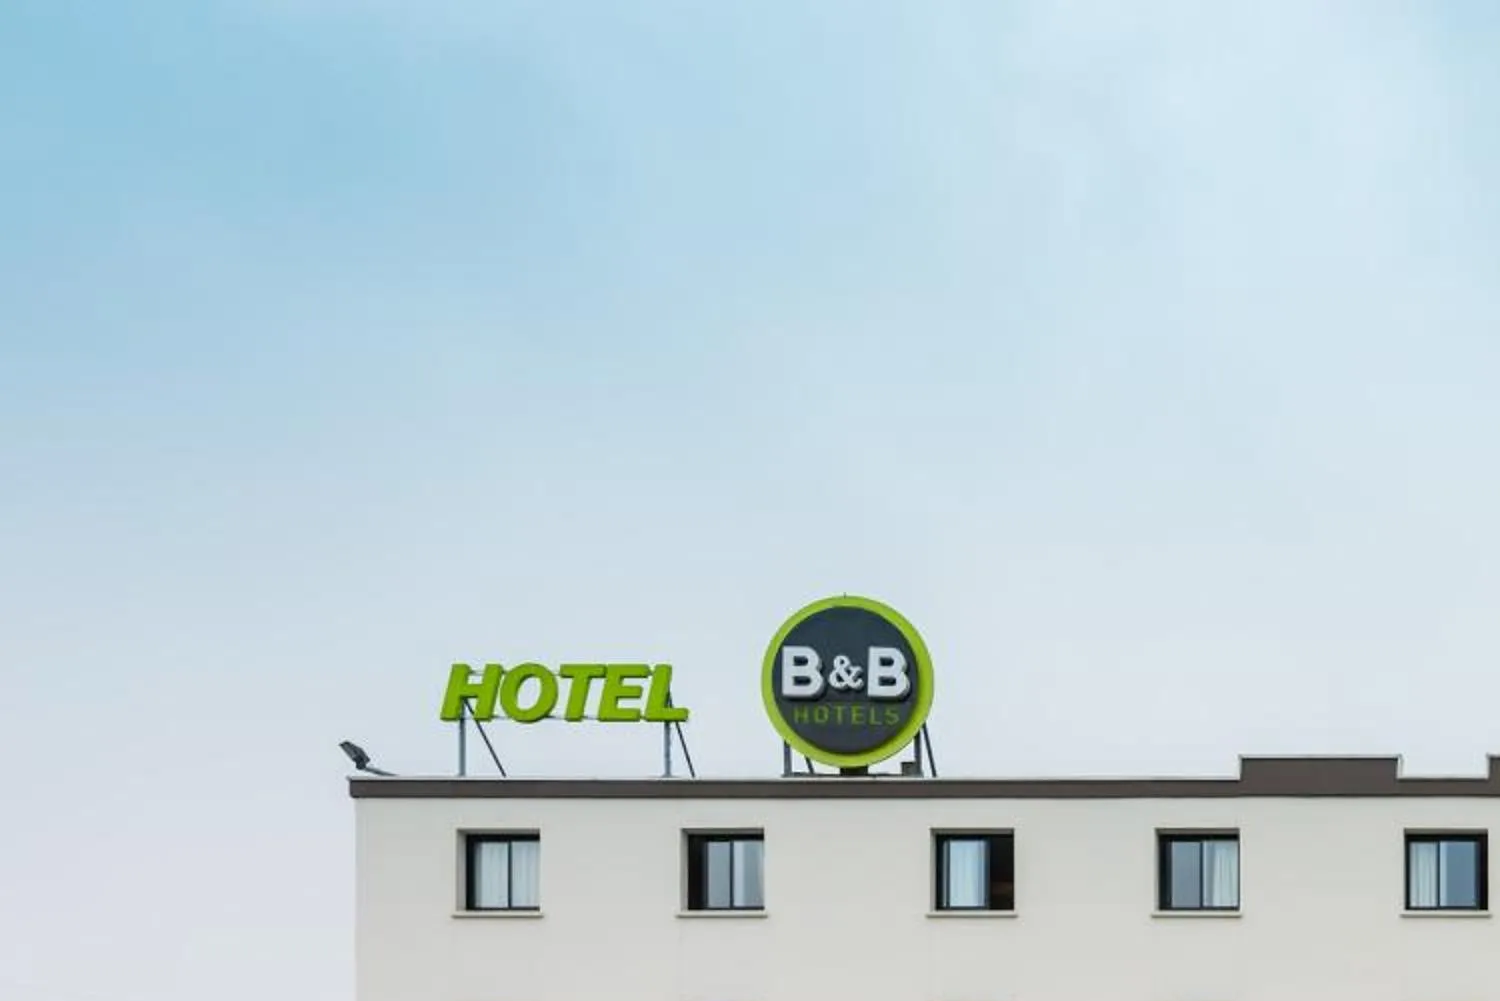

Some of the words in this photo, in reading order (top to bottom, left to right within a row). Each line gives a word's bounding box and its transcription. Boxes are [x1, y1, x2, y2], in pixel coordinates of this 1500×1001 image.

[440, 662, 690, 722] HOTEL
[781, 645, 911, 700] B&B
[793, 705, 900, 726] HOTELS
